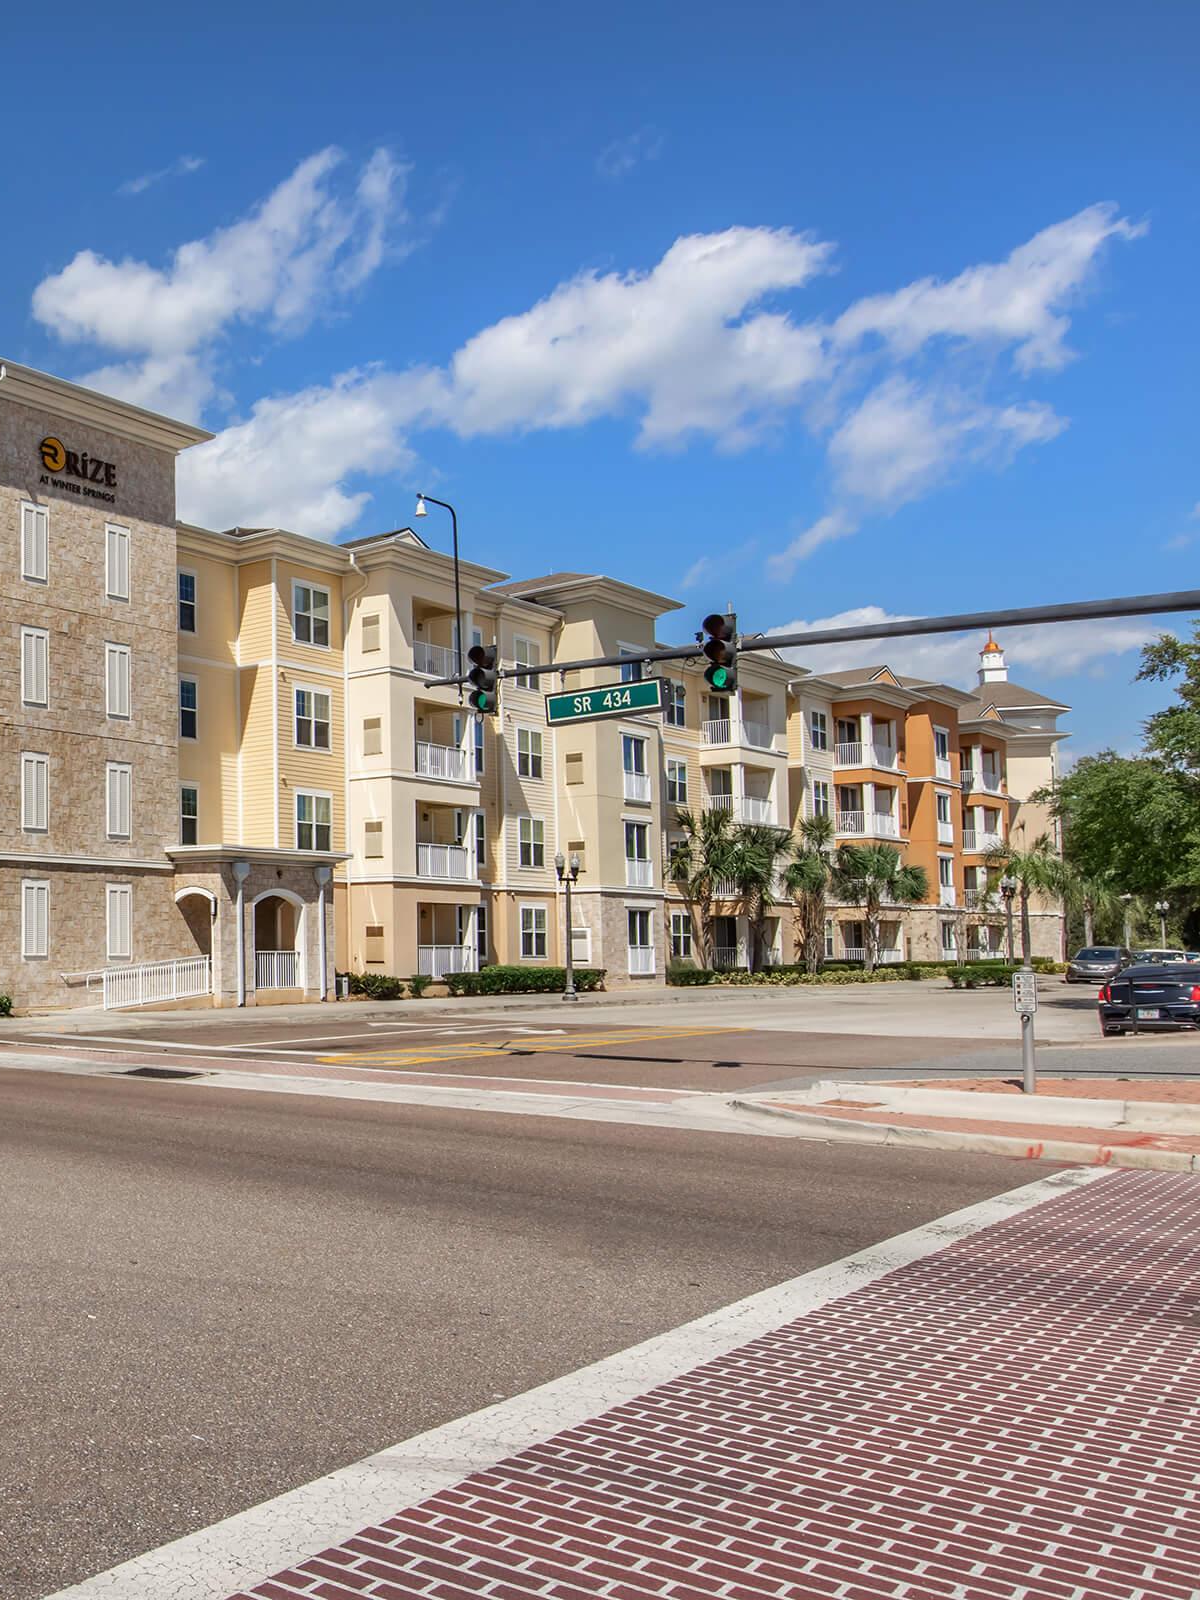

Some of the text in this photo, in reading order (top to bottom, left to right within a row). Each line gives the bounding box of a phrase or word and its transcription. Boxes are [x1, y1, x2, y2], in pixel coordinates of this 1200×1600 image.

[39, 474, 116, 503] AT WINTER SPRINGS
[573, 690, 631, 713] SR 434
